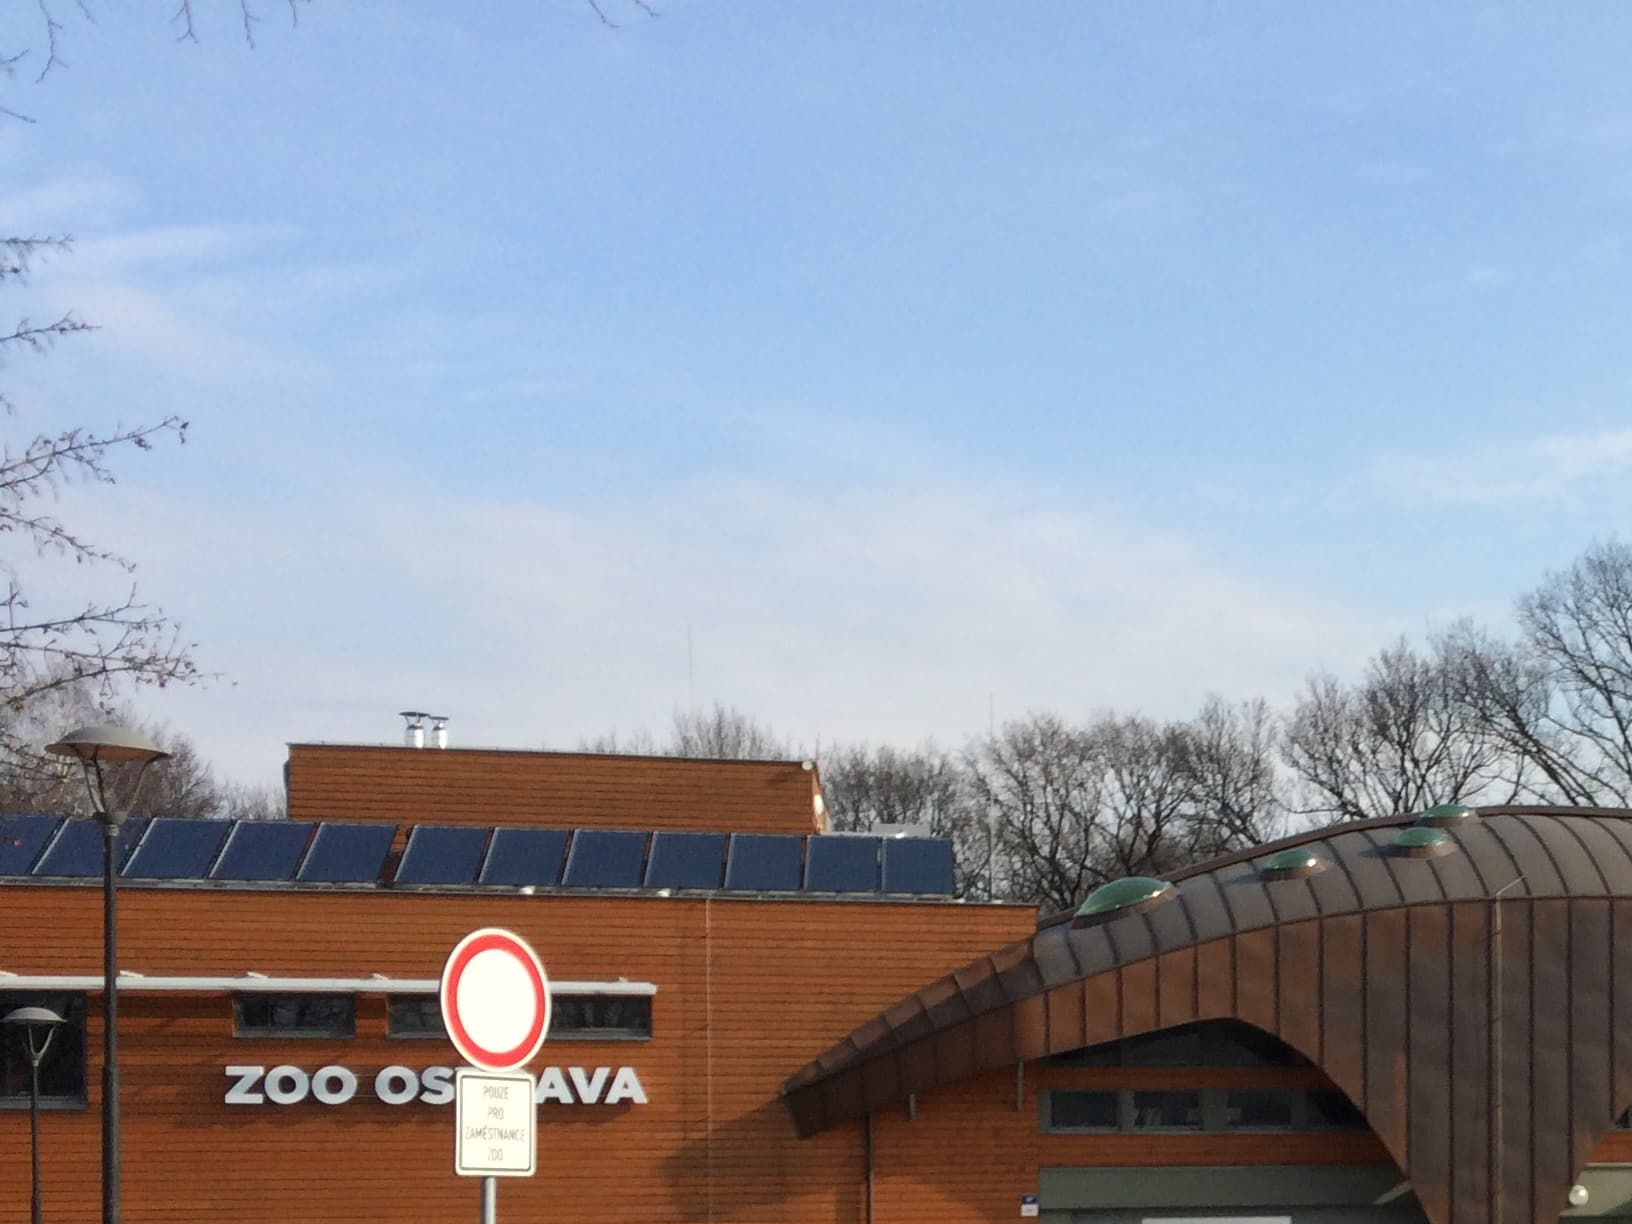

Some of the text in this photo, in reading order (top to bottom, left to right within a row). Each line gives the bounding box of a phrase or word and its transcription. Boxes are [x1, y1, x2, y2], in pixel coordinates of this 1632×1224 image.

[225, 1065, 648, 1105] ZOO OSAVA
[483, 1085, 510, 1100] POUZE
[487, 1106, 505, 1121] PRO
